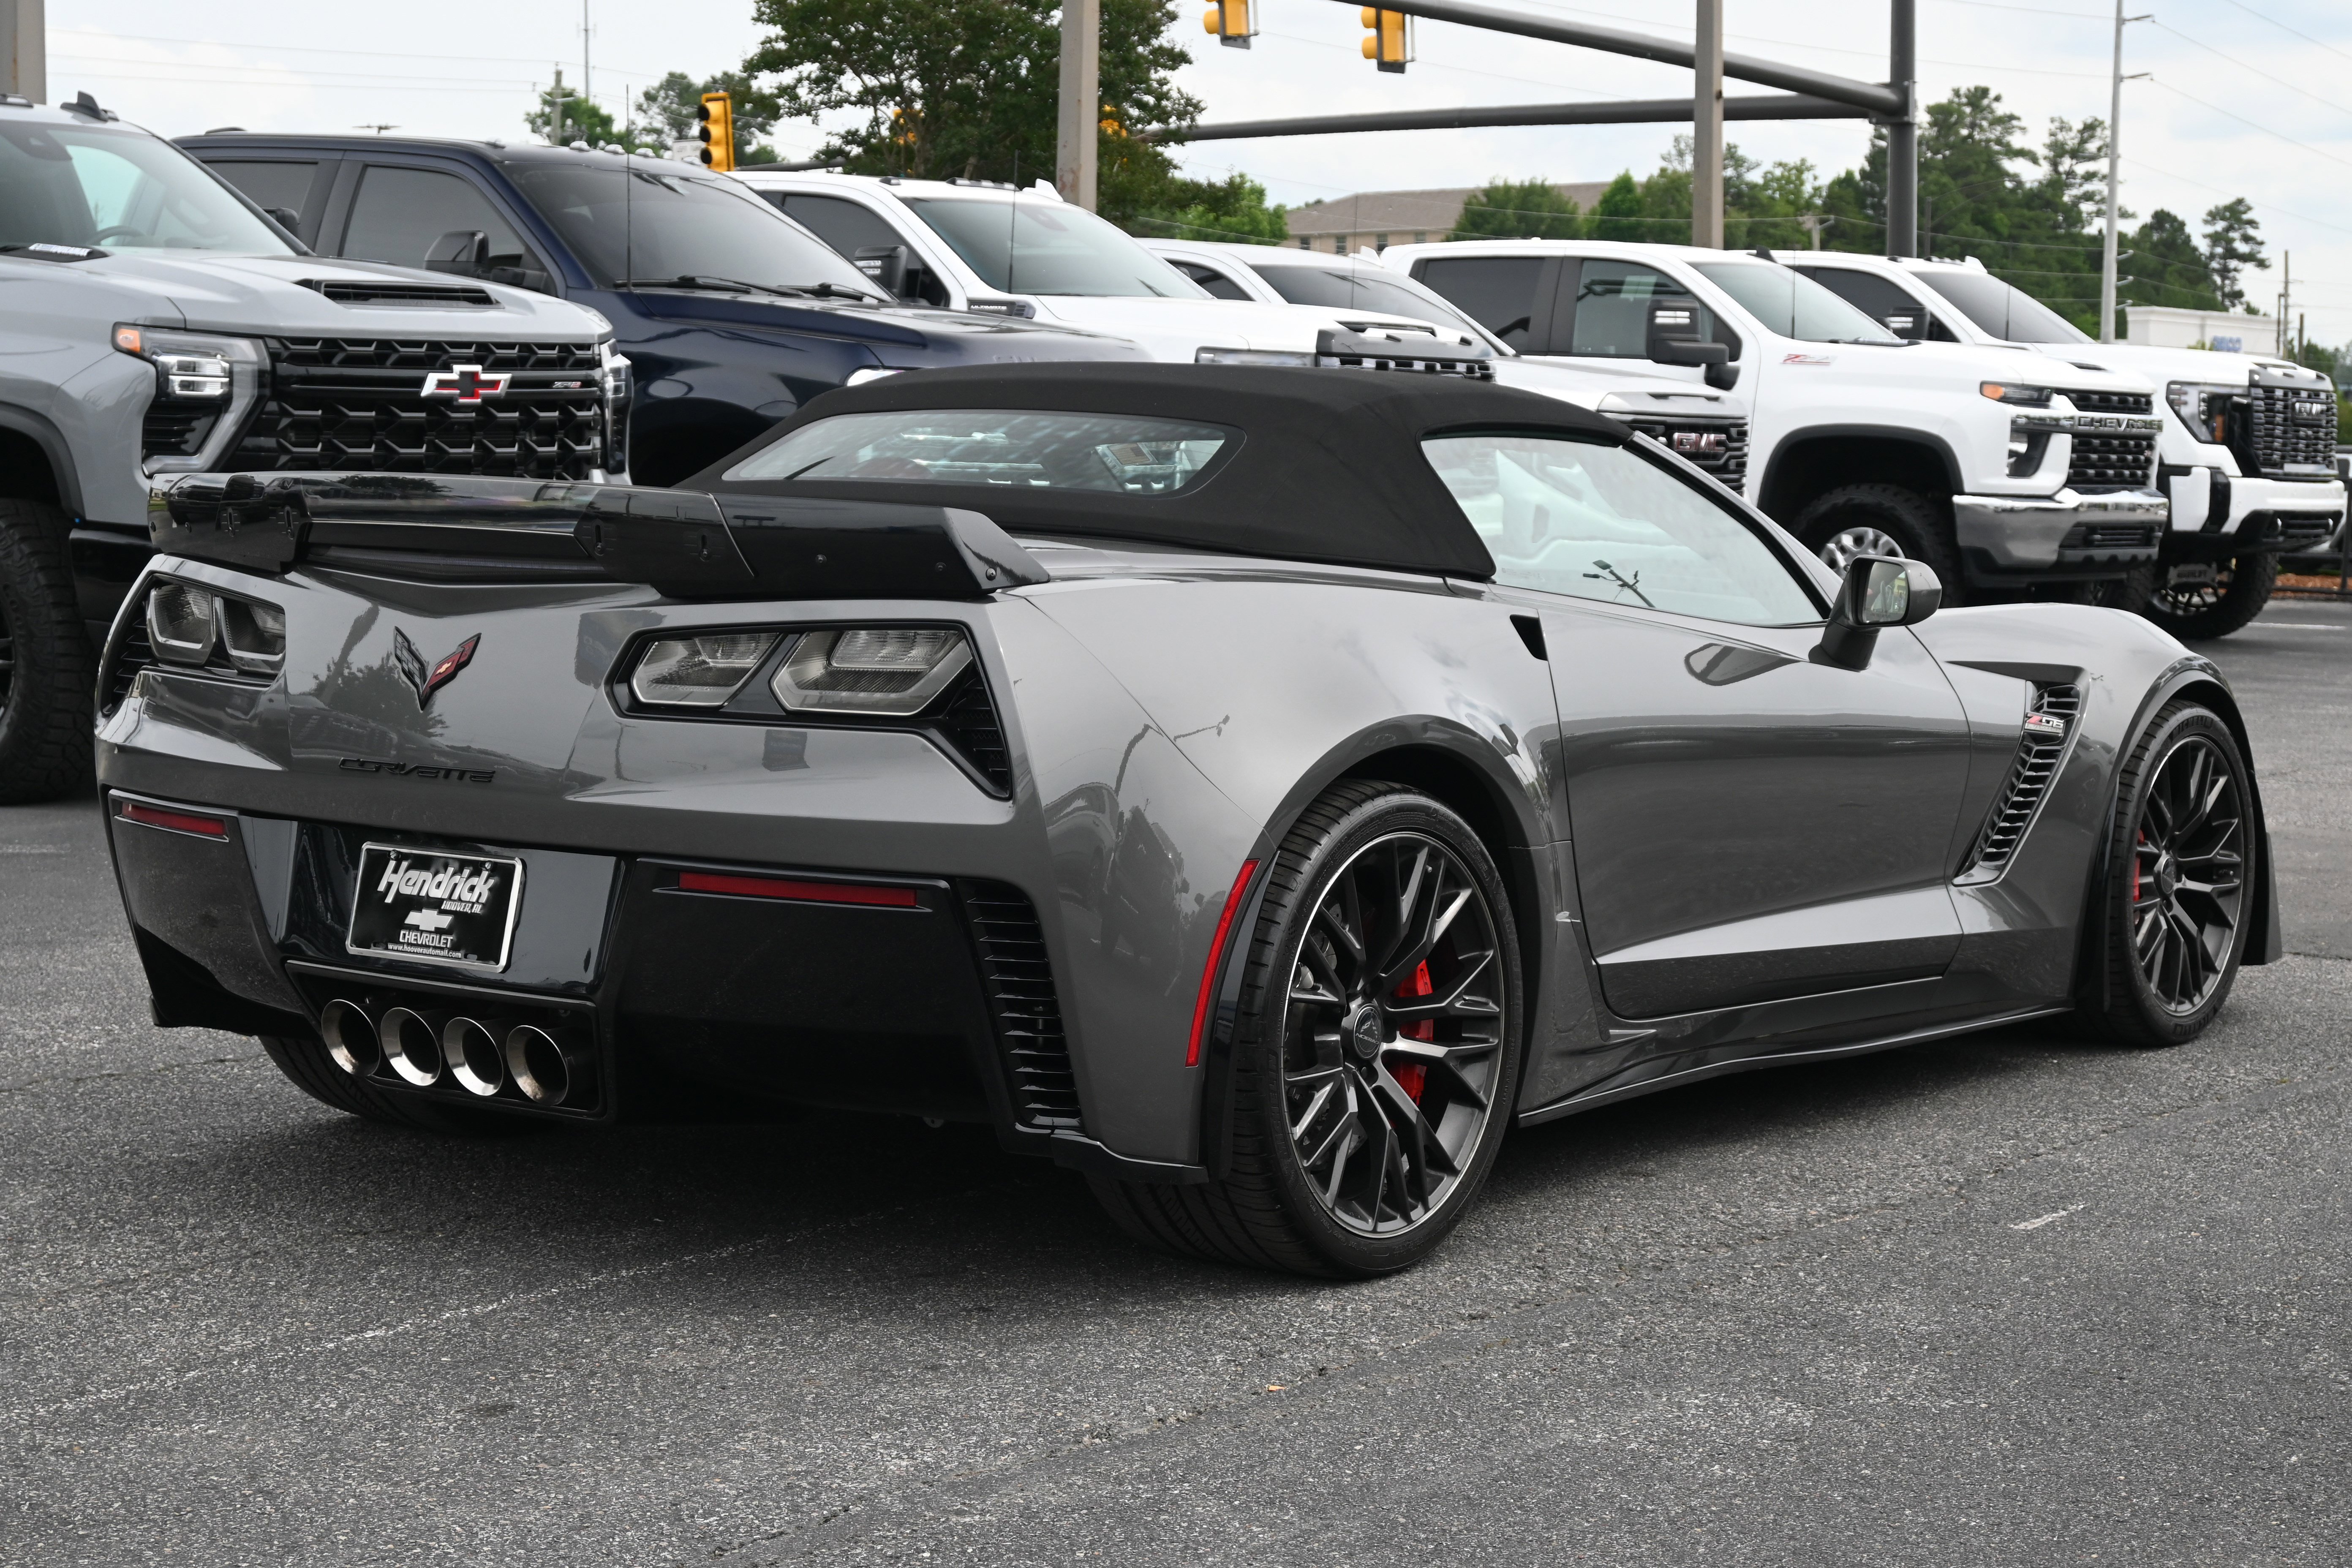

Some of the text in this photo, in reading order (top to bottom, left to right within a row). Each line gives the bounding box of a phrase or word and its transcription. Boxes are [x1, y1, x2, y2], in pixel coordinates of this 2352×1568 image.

[2078, 416, 2163, 433] CHEVROLET
[1673, 432, 1728, 452] GMC
[2026, 713, 2065, 729] Z06
[338, 757, 496, 783] CORVETTE
[376, 860, 495, 903] Hendrick
[441, 901, 482, 914] HOOVER, AL
[399, 931, 453, 948] CHEVROLET
[387, 942, 461, 959] www.hooverautomall.com
[1355, 1033, 1379, 1044] CARBON
[1267, 1053, 1290, 1161] MICHELIN
